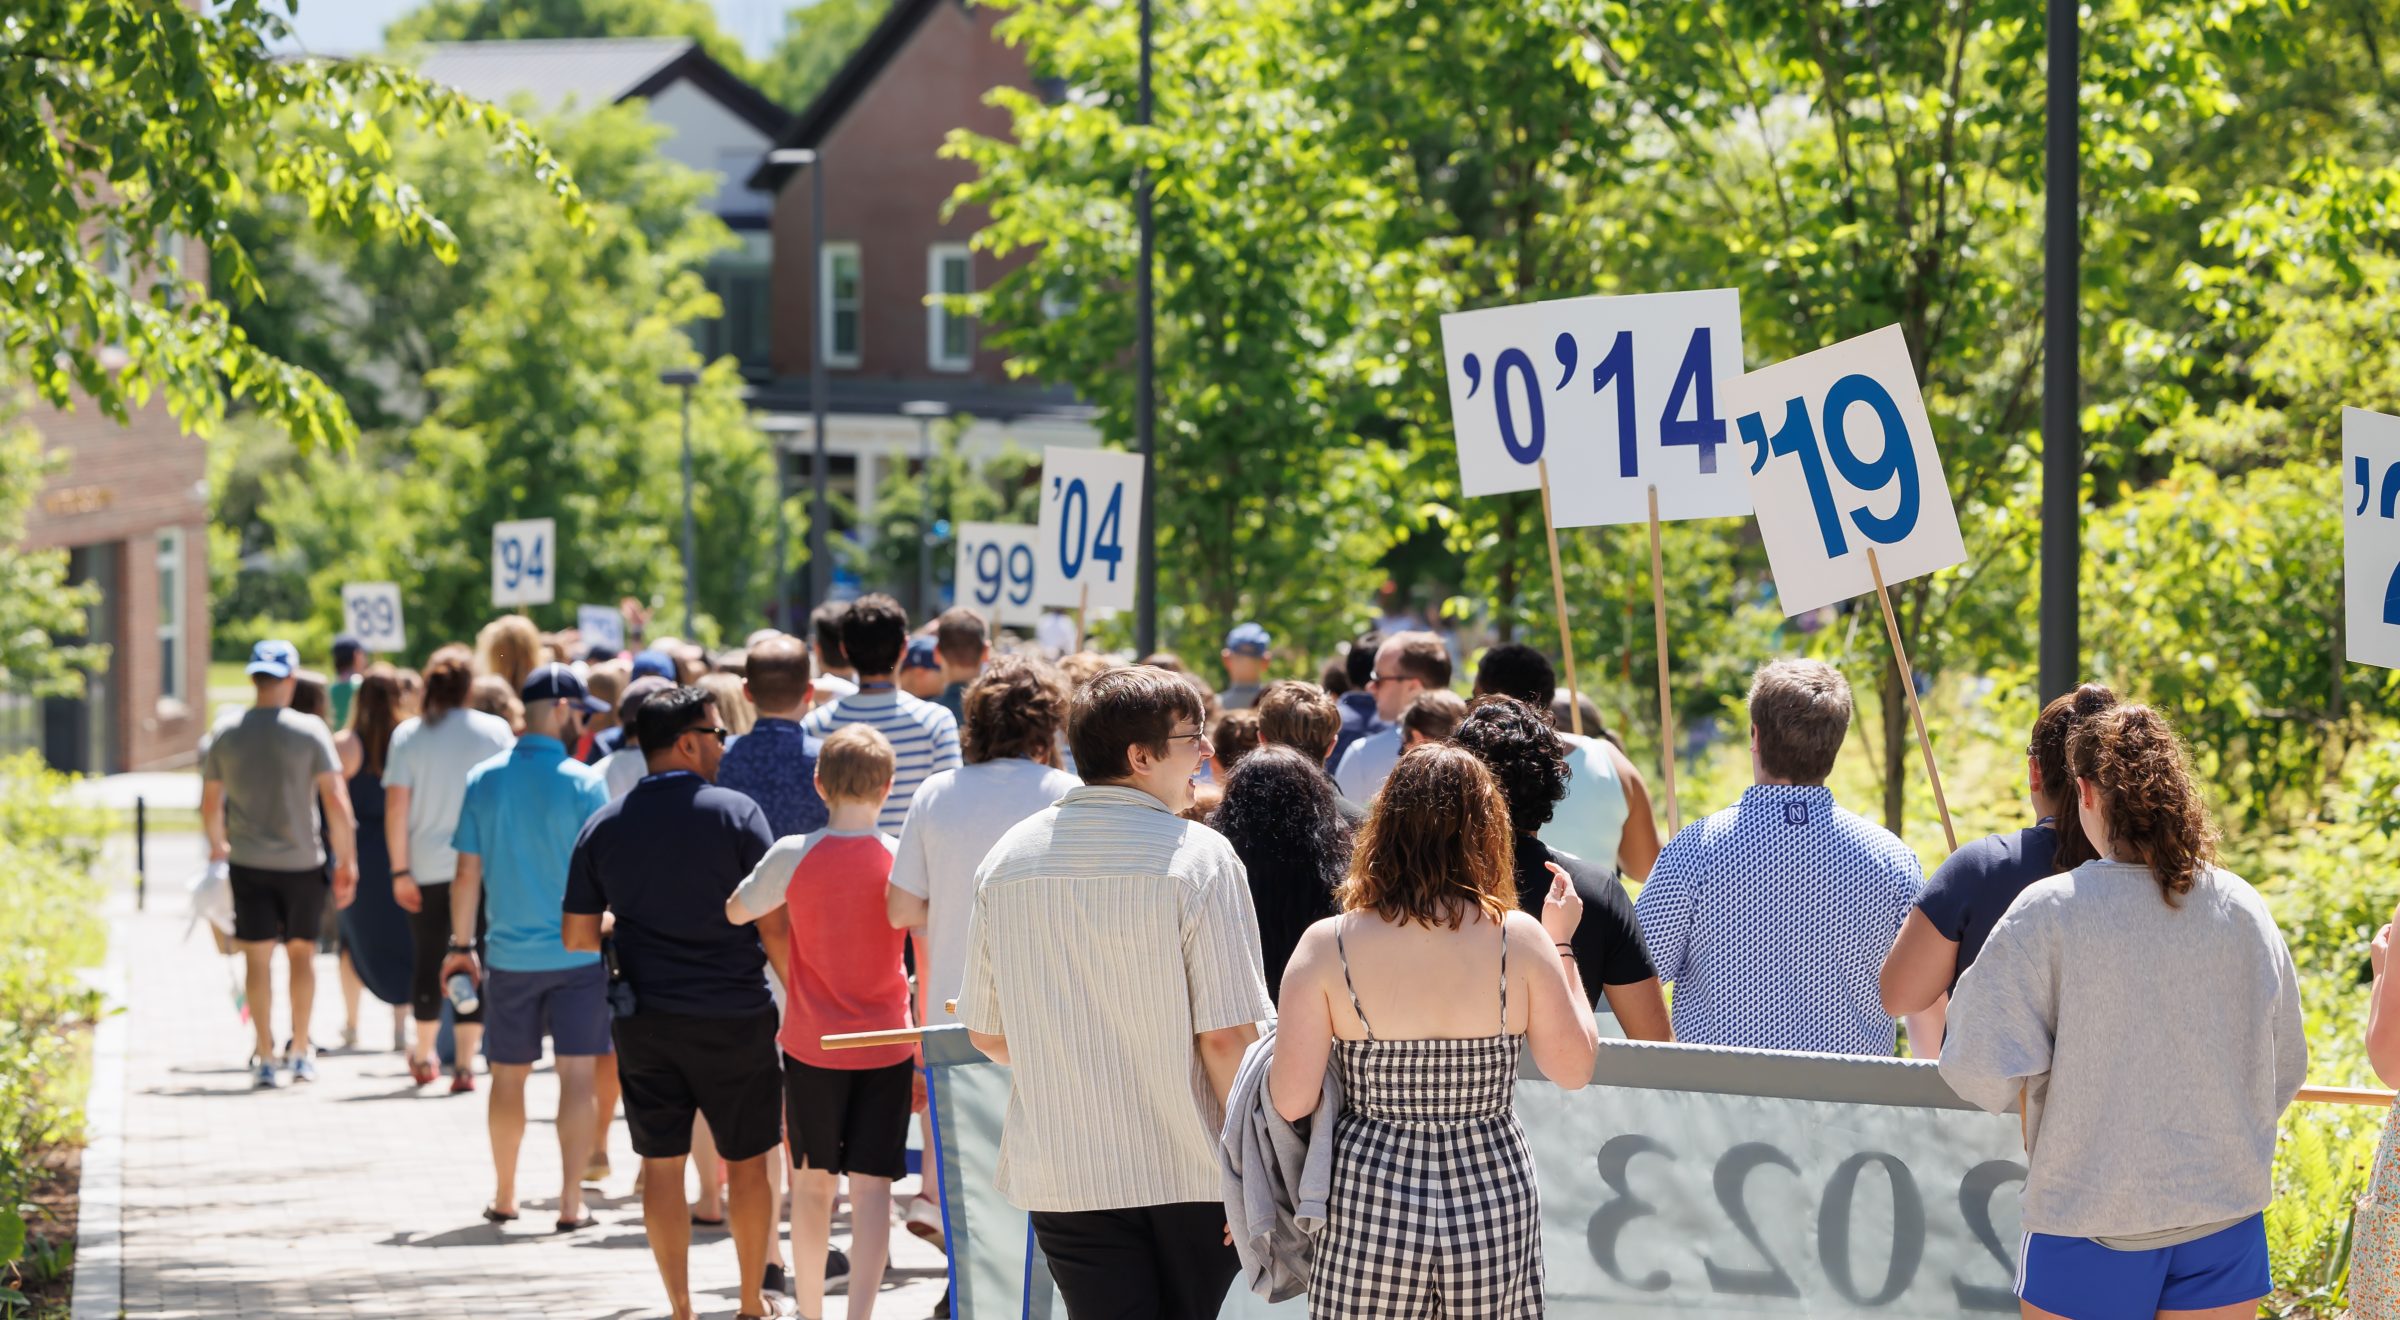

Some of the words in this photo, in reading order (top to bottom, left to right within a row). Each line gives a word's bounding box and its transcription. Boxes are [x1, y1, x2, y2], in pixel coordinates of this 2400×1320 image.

[1462, 347, 1546, 465] '0
[1555, 326, 1727, 478] '14
[1736, 373, 1921, 559] '19
[496, 535, 544, 590] '94
[965, 541, 1035, 606] '99
[1053, 476, 1124, 582] '04
